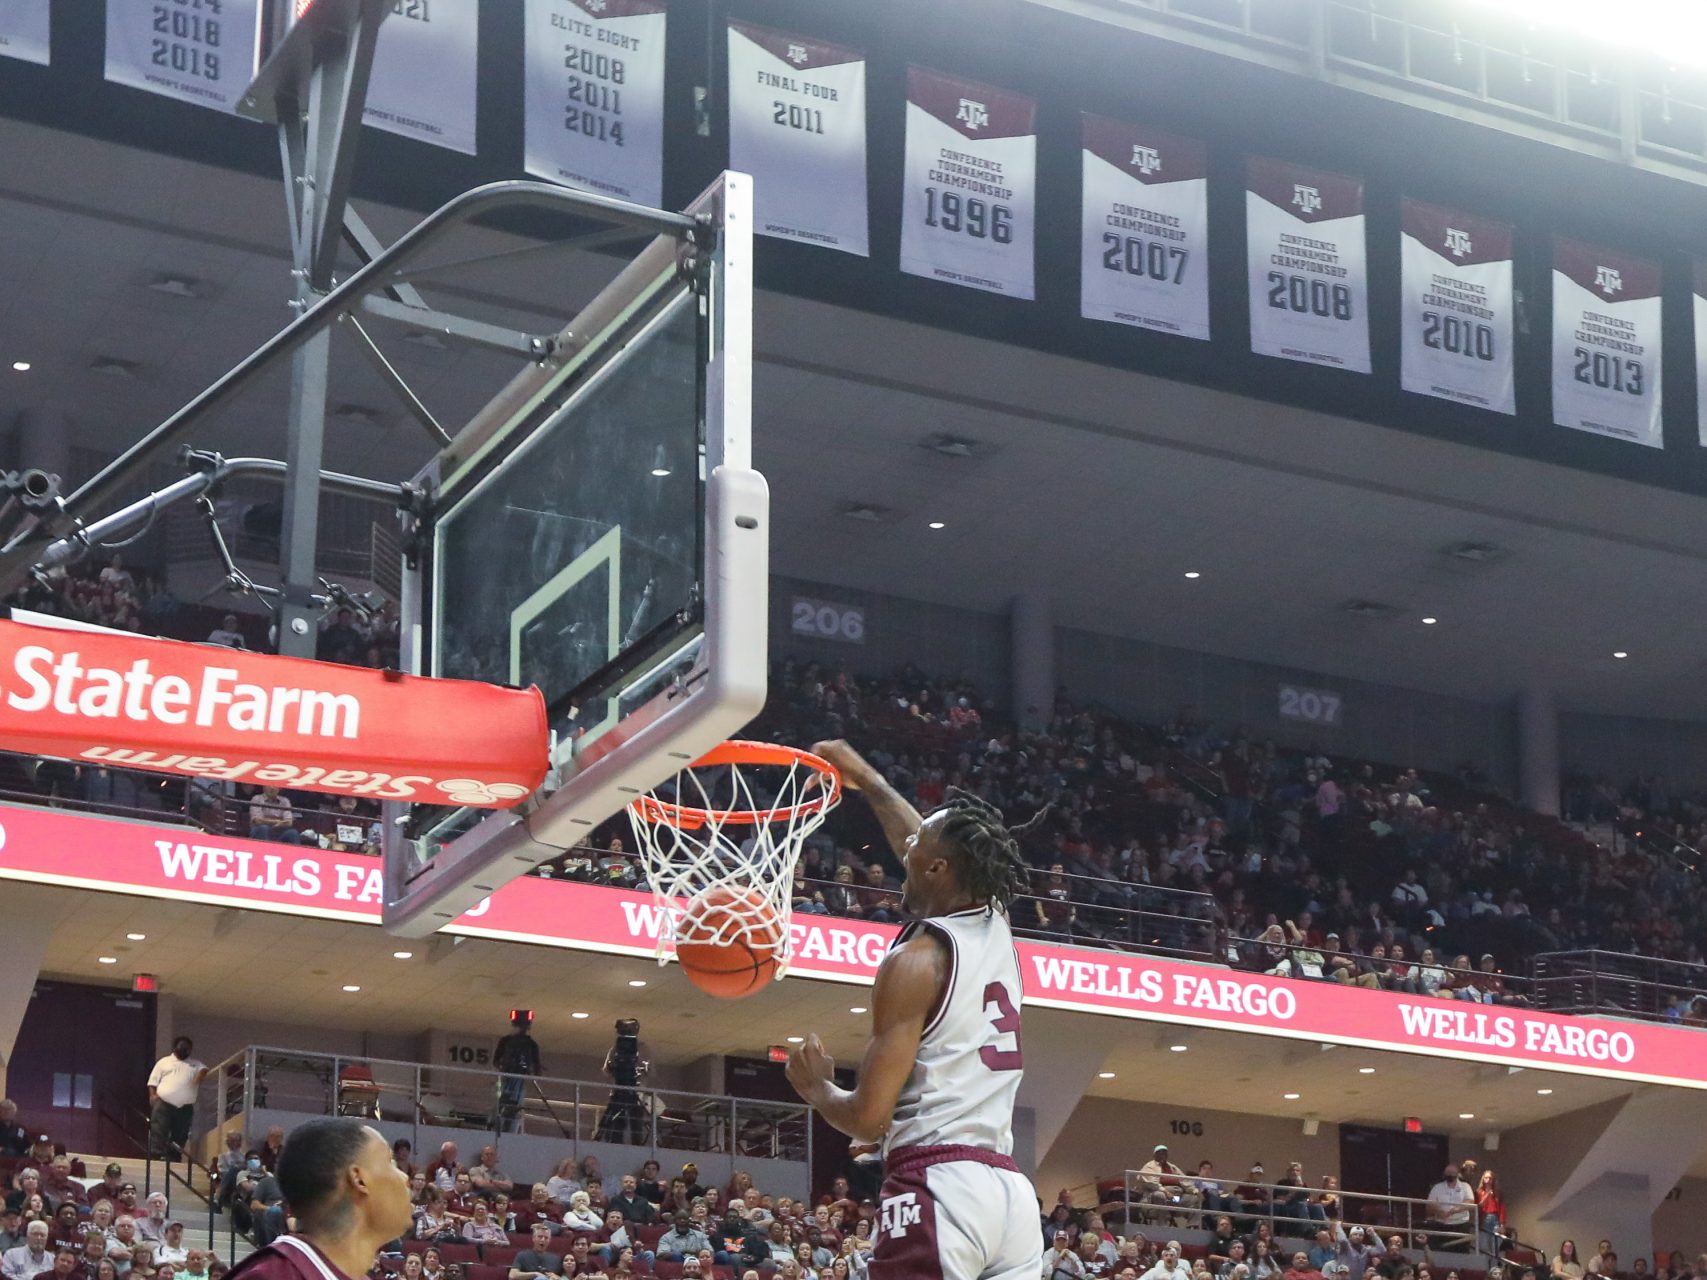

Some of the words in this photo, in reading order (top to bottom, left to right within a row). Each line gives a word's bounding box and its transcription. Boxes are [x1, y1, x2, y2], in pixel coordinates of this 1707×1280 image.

[153, 5, 220, 47] 2018
[551, 13, 592, 37] ELITE
[597, 28, 640, 51] EIGHT
[152, 39, 219, 80] 2019
[564, 44, 625, 85] 2008
[568, 75, 622, 115] 2011
[757, 71, 799, 92] FINAL
[803, 83, 838, 101] FOUR
[565, 105, 625, 147] 2014
[774, 100, 824, 134] 2011
[938, 160, 1004, 184] TOURNAMENT
[940, 148, 1002, 172] CONFERENCE
[929, 169, 1013, 200] CHAMPIONSHIP
[925, 187, 1013, 244] 1996
[1106, 214, 1186, 241] CHAMPIONSHIP
[1113, 203, 1180, 227] CONFERENCE
[1103, 231, 1189, 284] 2007
[1278, 244, 1339, 264] TOURNAMENT
[1280, 233, 1336, 253] CONFERENCE
[1271, 254, 1347, 278] CHAMPIONSHIP
[1268, 270, 1352, 321] 2008
[1431, 284, 1488, 306] TOURNAMENT
[1432, 274, 1486, 294] CONFERENCE
[1423, 294, 1494, 320] CHAMPIONSHIP
[1582, 310, 1635, 330] CONFERENCE
[1423, 311, 1494, 361] 2010
[1575, 330, 1644, 355] CHAMPIONSHIP
[1581, 321, 1636, 341] TOURNAMENT
[1574, 346, 1644, 396] 2013
[792, 602, 863, 638] 206
[1280, 688, 1340, 722] 207
[155, 840, 321, 896] WELLS
[1032, 956, 1163, 1003] WELLS
[1172, 974, 1296, 1020] FARGO
[979, 981, 1023, 1071] 3
[1398, 1004, 1516, 1048] WELLS
[1524, 1020, 1635, 1063] FARGO
[449, 1045, 489, 1064] 105
[1170, 1120, 1203, 1136] 106
